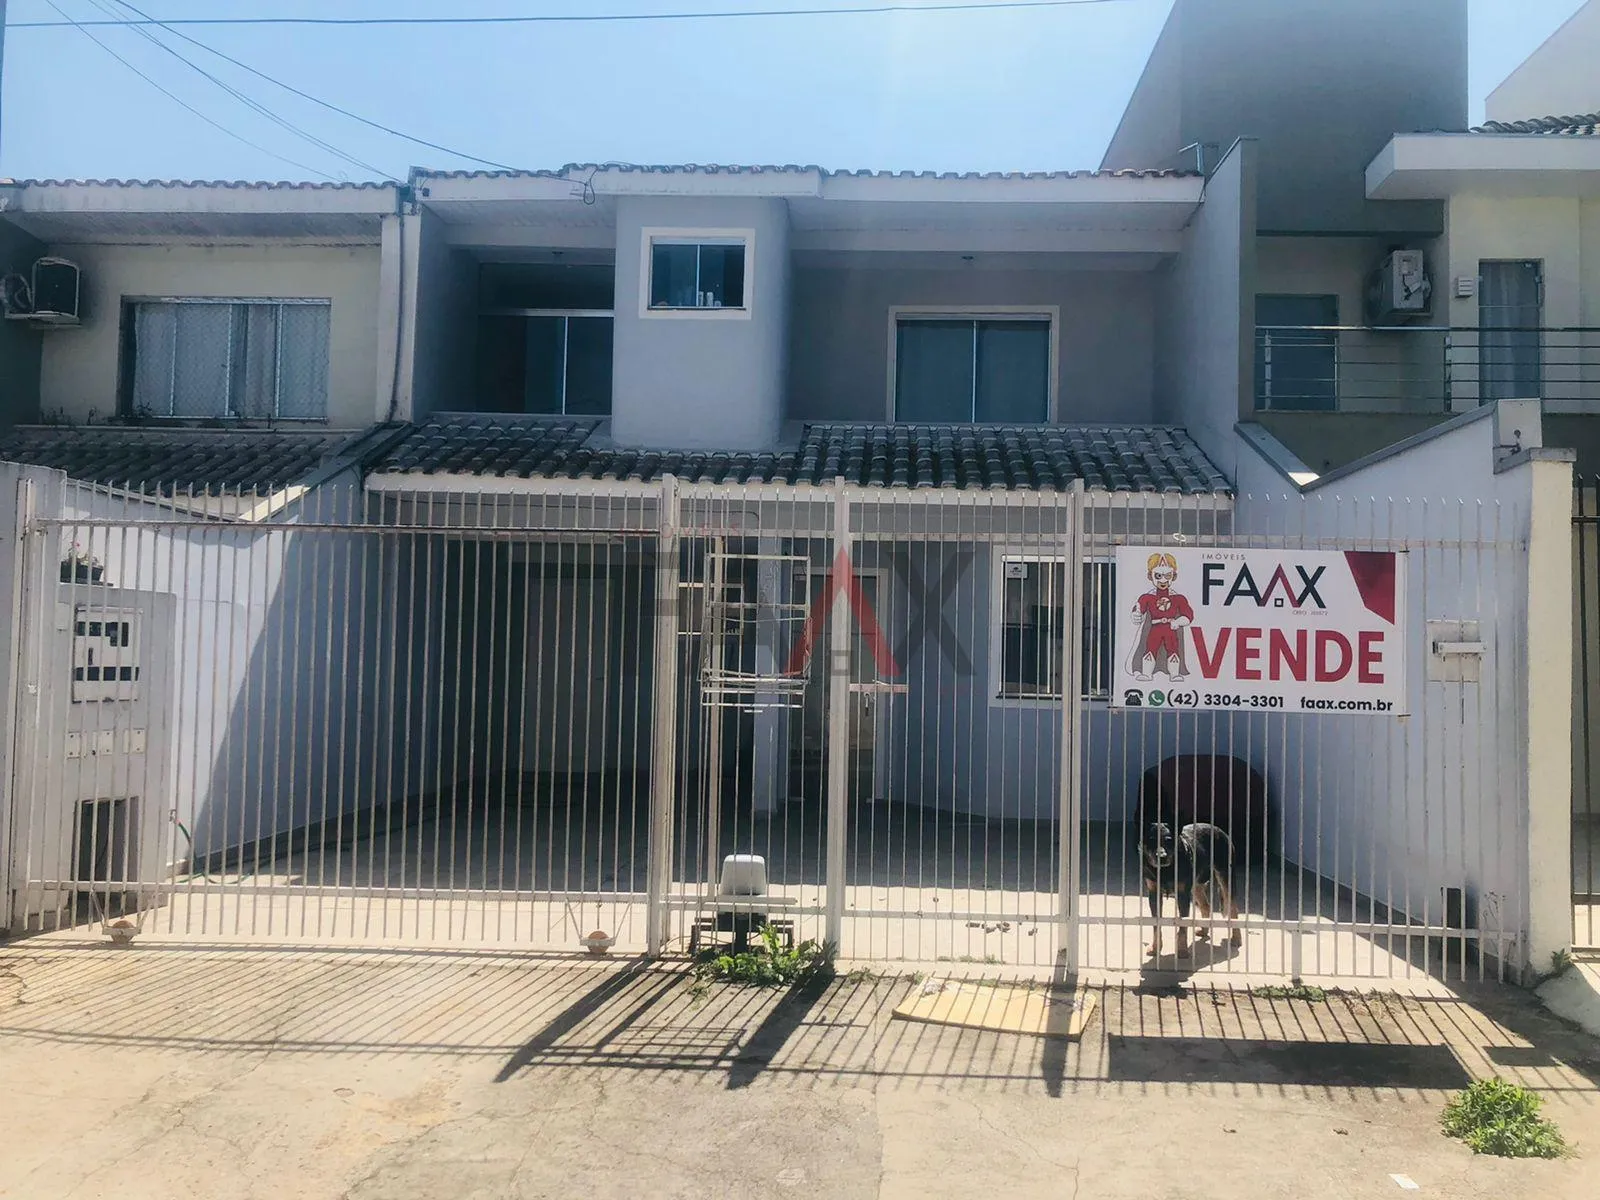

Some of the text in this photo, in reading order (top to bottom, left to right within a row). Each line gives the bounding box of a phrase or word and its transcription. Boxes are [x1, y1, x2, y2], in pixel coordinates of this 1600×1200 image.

[1202, 562, 1327, 609] FAAX
[1191, 626, 1385, 684] VENDE
[1167, 689, 1393, 712] (42) 3304-3301 faax.com.br
